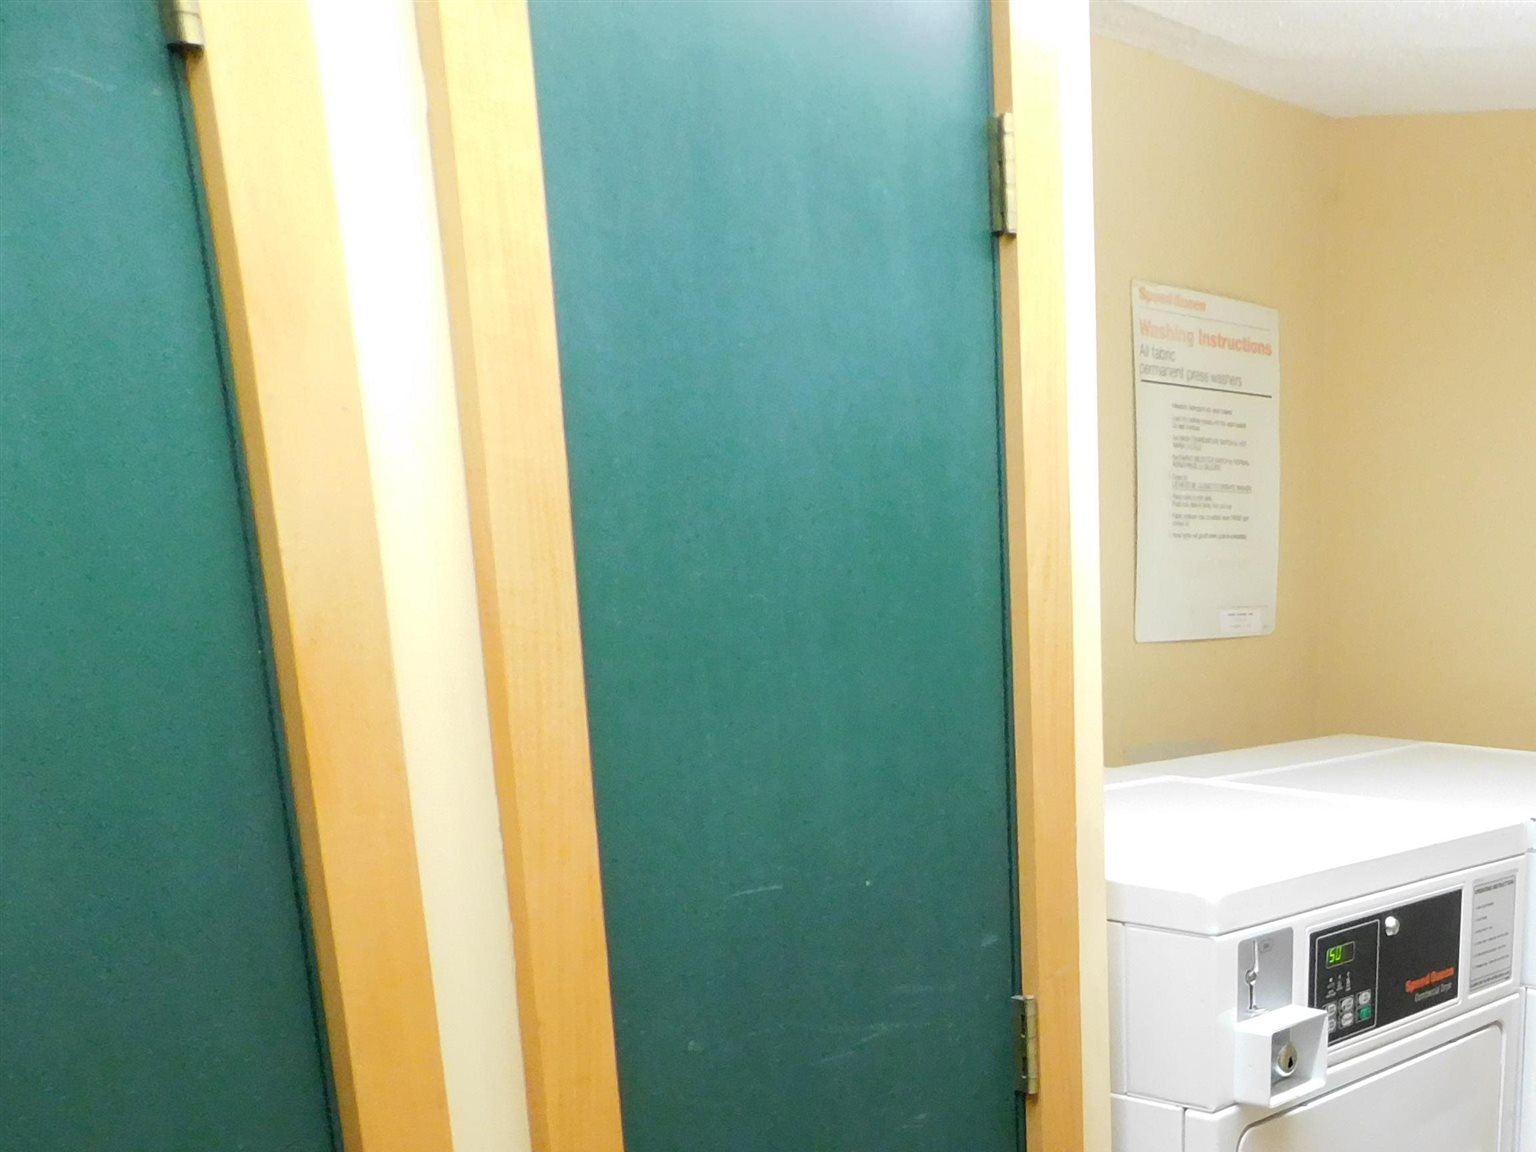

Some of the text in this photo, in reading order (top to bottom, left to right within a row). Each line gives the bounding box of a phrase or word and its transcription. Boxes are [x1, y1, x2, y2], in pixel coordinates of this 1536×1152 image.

[1139, 318, 1272, 356] Washing Instructions
[1186, 367, 1210, 383] press
